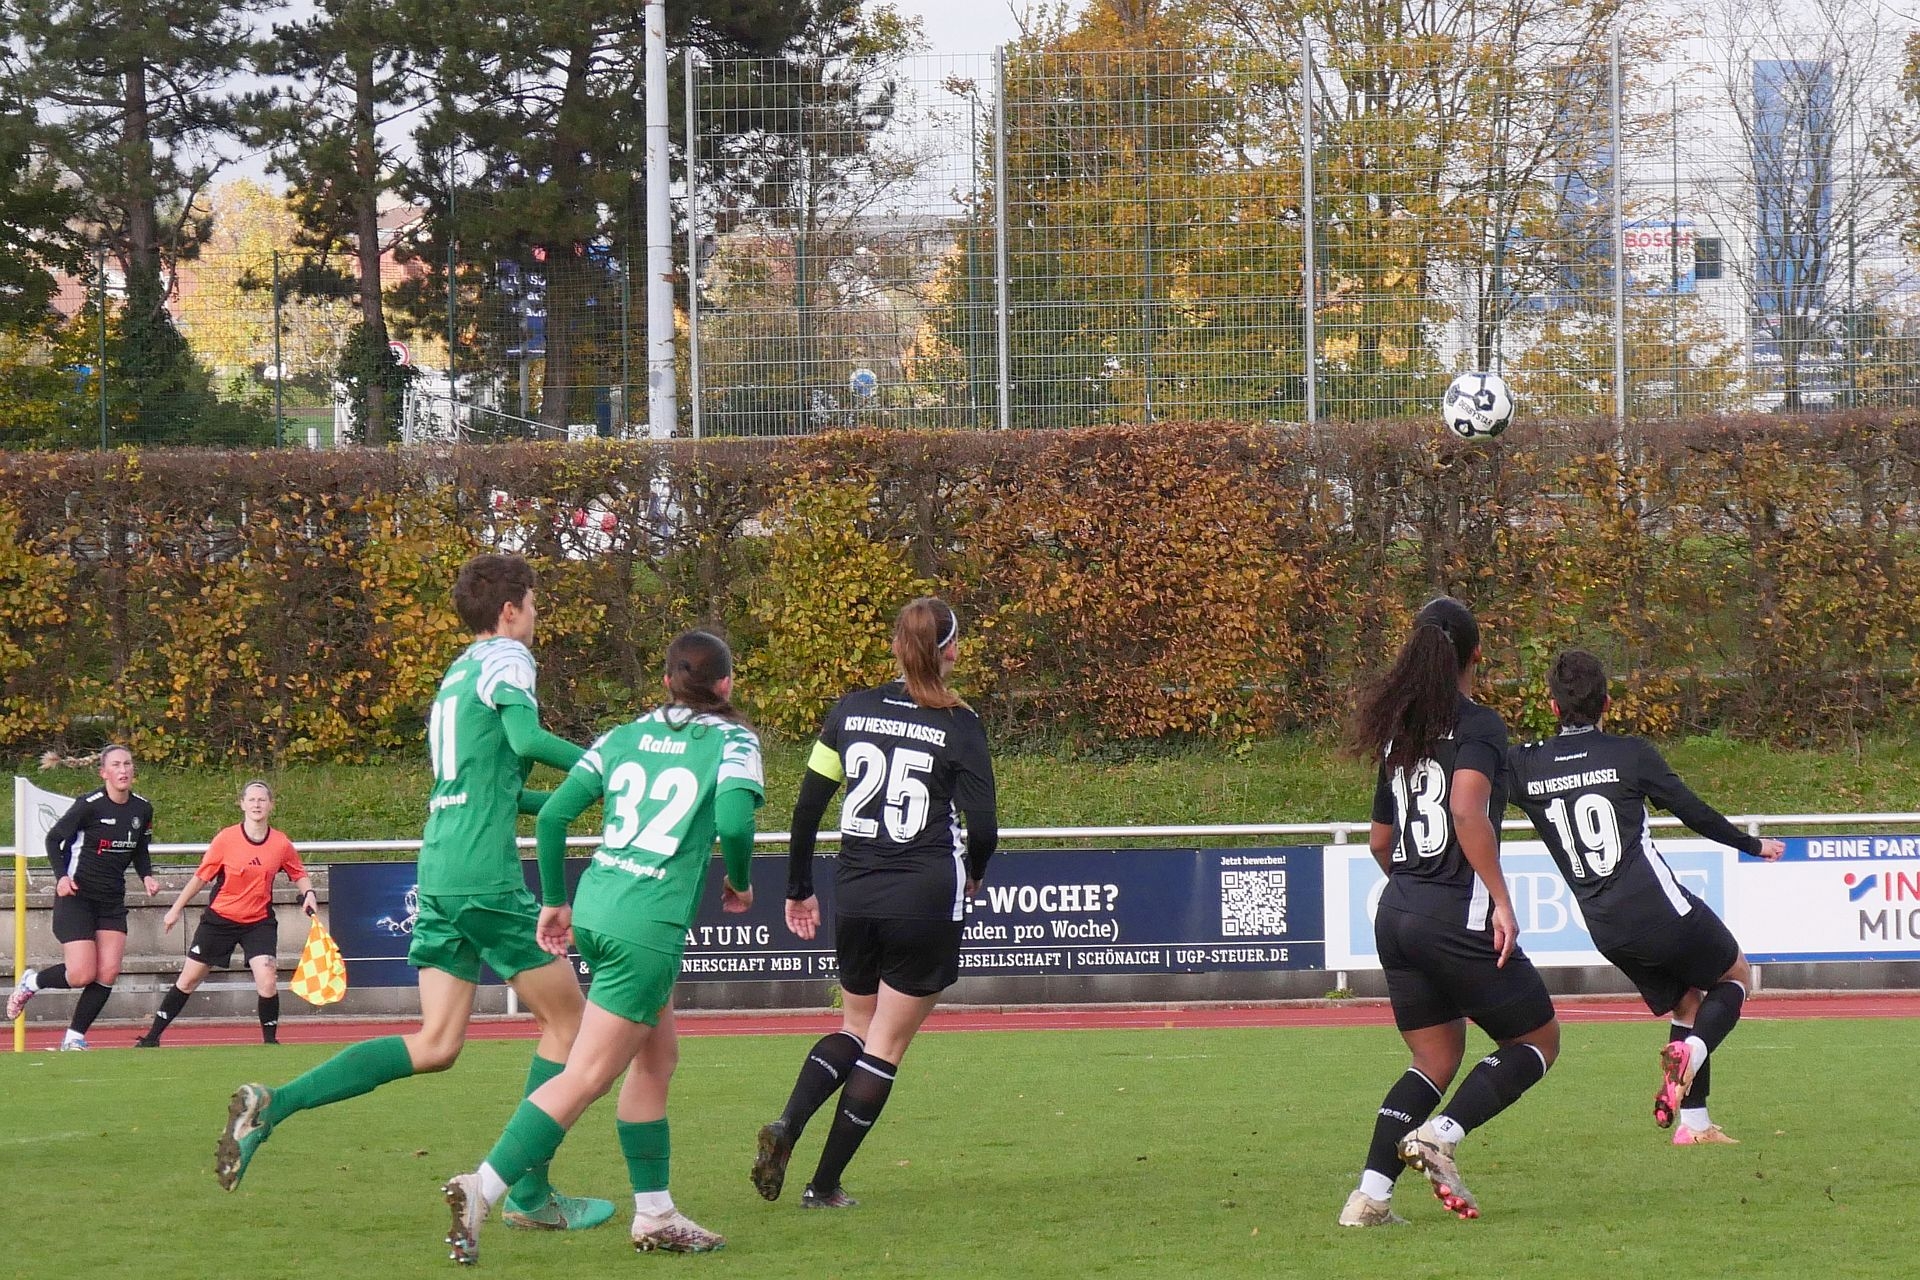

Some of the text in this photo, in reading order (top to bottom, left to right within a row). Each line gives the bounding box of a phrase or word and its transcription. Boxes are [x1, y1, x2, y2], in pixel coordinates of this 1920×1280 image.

[1459, 399, 1494, 427] DERBYSTAR
[638, 734, 687, 754] Rahm
[845, 716, 946, 747] KSV HESSEN KASSEL
[841, 742, 934, 843] 25
[1527, 768, 1620, 795] KSV HESSEN KASSEL
[604, 761, 699, 857] 32
[1391, 757, 1448, 862] 13
[1544, 793, 1622, 878] 19
[1807, 840, 1870, 858] DEINE
[1221, 855, 1286, 866] Jetzt bewerben!
[1014, 924, 1044, 943] pro
[1051, 918, 1119, 942] Woche)
[579, 961, 590, 974] &
[682, 957, 765, 973] NERSCHAFT
[770, 956, 802, 971] MBB
[1077, 949, 1160, 966] SCHÖNAICH
[1176, 948, 1289, 964] UGP-STEUER.DE
